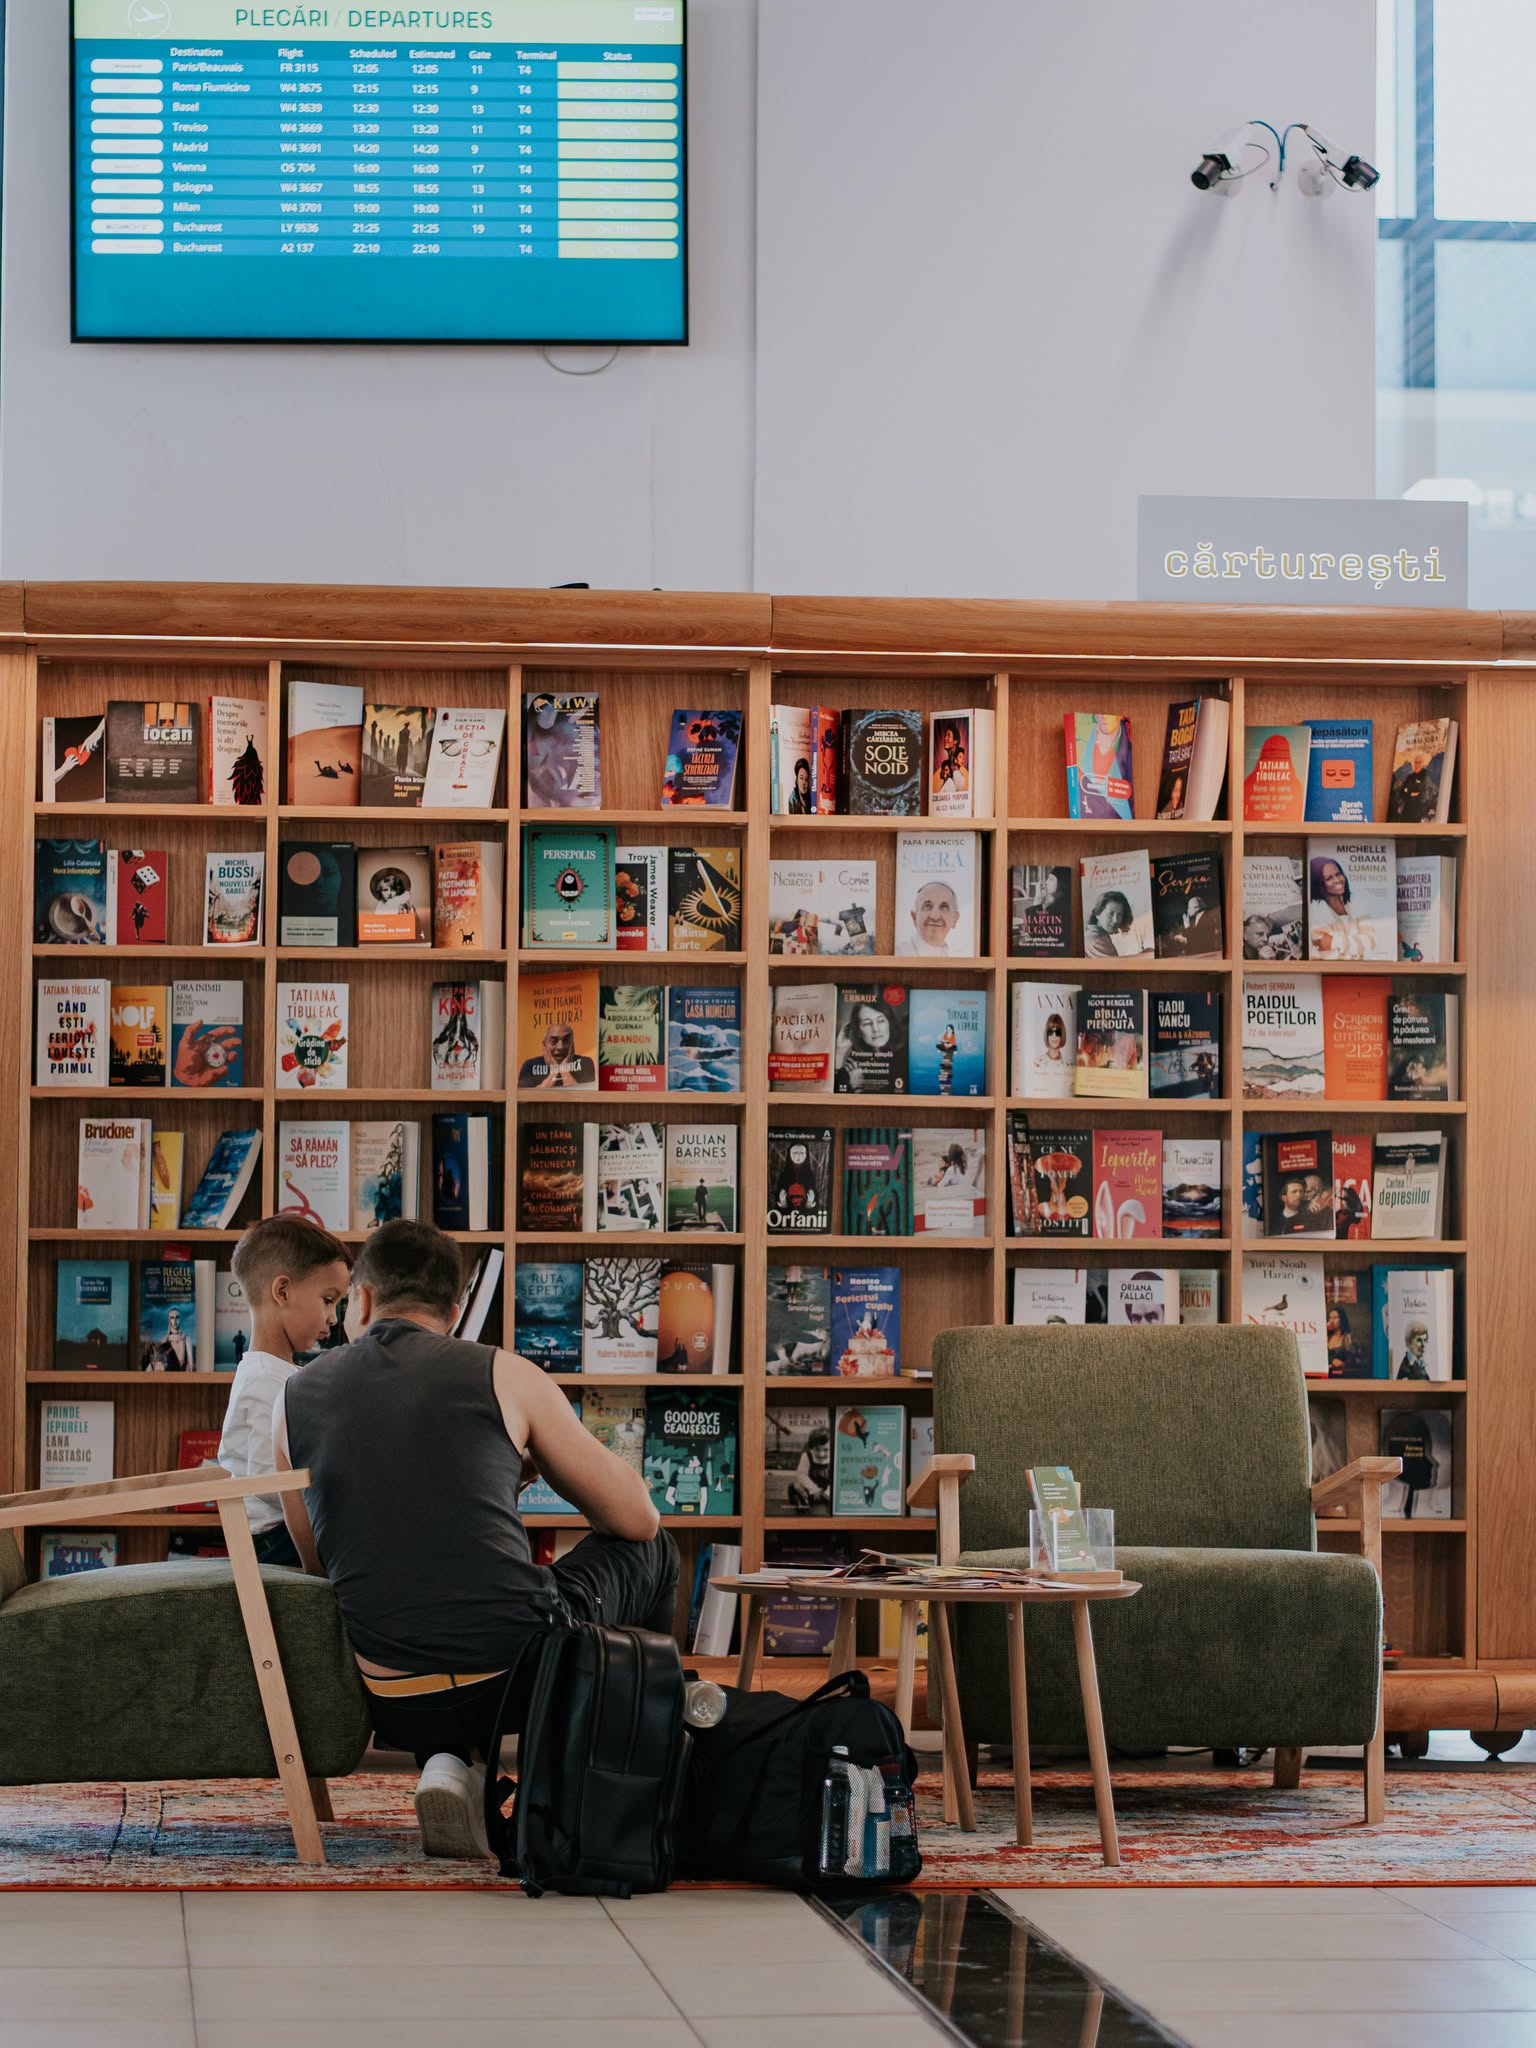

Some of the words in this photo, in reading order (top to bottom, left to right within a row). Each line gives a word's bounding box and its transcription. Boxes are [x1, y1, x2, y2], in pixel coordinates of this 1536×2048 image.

[235, 5, 328, 27] PLECĂRI
[348, 10, 493, 28] DEPARTURES
[170, 47, 223, 57] Destination
[277, 48, 304, 59] Flight
[349, 49, 397, 59] Scheduled
[409, 50, 456, 60] Estimated
[468, 50, 492, 60] Gate
[516, 50, 557, 60] Terminal
[602, 51, 633, 61] Status
[173, 62, 243, 73] Paris/Beauvais
[281, 63, 293, 74] FR
[353, 63, 380, 74] 12:05
[412, 64, 439, 75] 12:05
[471, 64, 483, 75] 11
[518, 65, 532, 75] T4
[173, 82, 201, 92] Roma
[202, 82, 250, 92] Fiumicino
[280, 83, 297, 93] W4
[353, 83, 380, 93] 12:15
[412, 84, 439, 94] 12:15
[173, 102, 199, 112] Basel
[280, 103, 297, 113] W4
[353, 103, 380, 113] 12:30
[412, 104, 439, 114] 12:30
[173, 122, 208, 132] Treviso
[280, 123, 297, 133] W4
[353, 123, 380, 133] 13:20
[412, 124, 439, 134] 13:20
[173, 142, 208, 152] Madrid
[280, 143, 297, 153] W4
[353, 143, 380, 153] 14:20
[412, 144, 439, 154] 14:20
[173, 162, 207, 172] Vienna
[281, 163, 296, 173] OS
[353, 163, 380, 173] 16:00
[412, 164, 439, 174] 16:00
[173, 182, 213, 194] Bologna
[281, 183, 297, 193] W4
[353, 183, 380, 193] 18:55
[412, 184, 439, 194] 18:55
[173, 202, 200, 212] Milan
[281, 203, 297, 213] W4
[353, 203, 380, 213] 19:00
[412, 204, 439, 214] 19:00
[173, 222, 222, 232] Bucharest
[281, 223, 294, 233] LY
[353, 223, 380, 233] 21:25
[412, 224, 439, 234] 21:25
[173, 242, 222, 252] Bucharest
[281, 243, 294, 253] A2
[353, 243, 380, 253] 22:10
[412, 244, 439, 254] 22:10
[1164, 541, 1446, 590] cărturești
[554, 698, 598, 709] KIWI
[866, 736, 906, 744] CĂRTĂRESCU
[865, 745, 909, 762] SOLE
[865, 762, 909, 775] NOID
[1258, 761, 1290, 770] TATIANA
[1341, 800, 1362, 809] Sarah
[1332, 813, 1363, 821] Williams
[543, 850, 596, 860] PERSEPOLIS
[1337, 845, 1387, 854] MICHELLE
[224, 859, 249, 867] MICHEL
[628, 853, 648, 864] Troy
[1350, 855, 1387, 863] OBAMA
[218, 866, 255, 879] BUSSI
[1349, 864, 1387, 873] LUMINA
[219, 880, 253, 888] NOUVELLE
[1159, 870, 1209, 896] Sergiu
[1023, 915, 1062, 925] MARTIN
[673, 926, 708, 938] Ultima
[673, 940, 701, 949] carte
[43, 985, 70, 996] TATIANA
[176, 983, 195, 993] ORA
[196, 984, 222, 993] INIMII
[1246, 983, 1268, 991] Robert
[290, 989, 336, 1002] TATIANA
[844, 994, 877, 1002] ERNAUX
[57, 1000, 87, 1014] CÂND
[438, 997, 475, 1015] KING
[1158, 1001, 1184, 1013] RADU
[1247, 995, 1299, 1009] RAIDUL
[685, 1000, 703, 1019] CASA
[705, 1004, 736, 1019] NUMELOR
[1095, 1008, 1127, 1019] BIBLIA
[111, 1005, 154, 1028] WOLF
[775, 1013, 825, 1026] PACIENTA
[1158, 1014, 1190, 1028] VANCU
[1247, 1010, 1316, 1028] POEȚILOR
[59, 1017, 84, 1030] EȘTI
[1086, 1017, 1135, 1030] PIERDUTĂ
[606, 1035, 651, 1044] ABANDON
[780, 1028, 820, 1041] TĂCUTĂ
[47, 1047, 96, 1060] LOVEȘTE
[307, 1049, 316, 1057] de
[1346, 1044, 1383, 1058] 2125
[50, 1063, 93, 1074] PRIMUL
[532, 1063, 548, 1076] GELU
[549, 1059, 582, 1075] DUMINICĂ
[85, 1123, 136, 1140] Bruckner
[290, 1137, 303, 1151] SĂ
[305, 1137, 338, 1151] RĂMÂN
[677, 1134, 726, 1145] JULIAN
[676, 1147, 727, 1158] BARNES
[1332, 1141, 1356, 1156] Rațiu
[295, 1152, 308, 1168] SĂ
[309, 1154, 338, 1168] PLEC?
[1385, 1177, 1405, 1189] Cartea
[1379, 1189, 1431, 1208] depresiilor
[767, 1210, 827, 1228] Orfanii
[1249, 1259, 1276, 1270] Yuval
[1280, 1259, 1307, 1269] Noah
[163, 1266, 191, 1277] REGELE
[1263, 1269, 1295, 1280] Harari
[163, 1276, 191, 1287] LEPROS
[531, 1273, 564, 1284] RUTA
[521, 1285, 575, 1296] SEPETYS
[1120, 1283, 1152, 1292] ORIANA
[835, 1293, 878, 1303] Fericitul
[1120, 1292, 1153, 1301] FALLACI
[865, 1302, 893, 1311] cuplu
[46, 1406, 80, 1419] PRINDE
[664, 1410, 720, 1425] GOODBYE
[46, 1421, 89, 1433] IEPURELE
[663, 1423, 720, 1437] CEAUȘESCU
[46, 1435, 70, 1448] LANA
